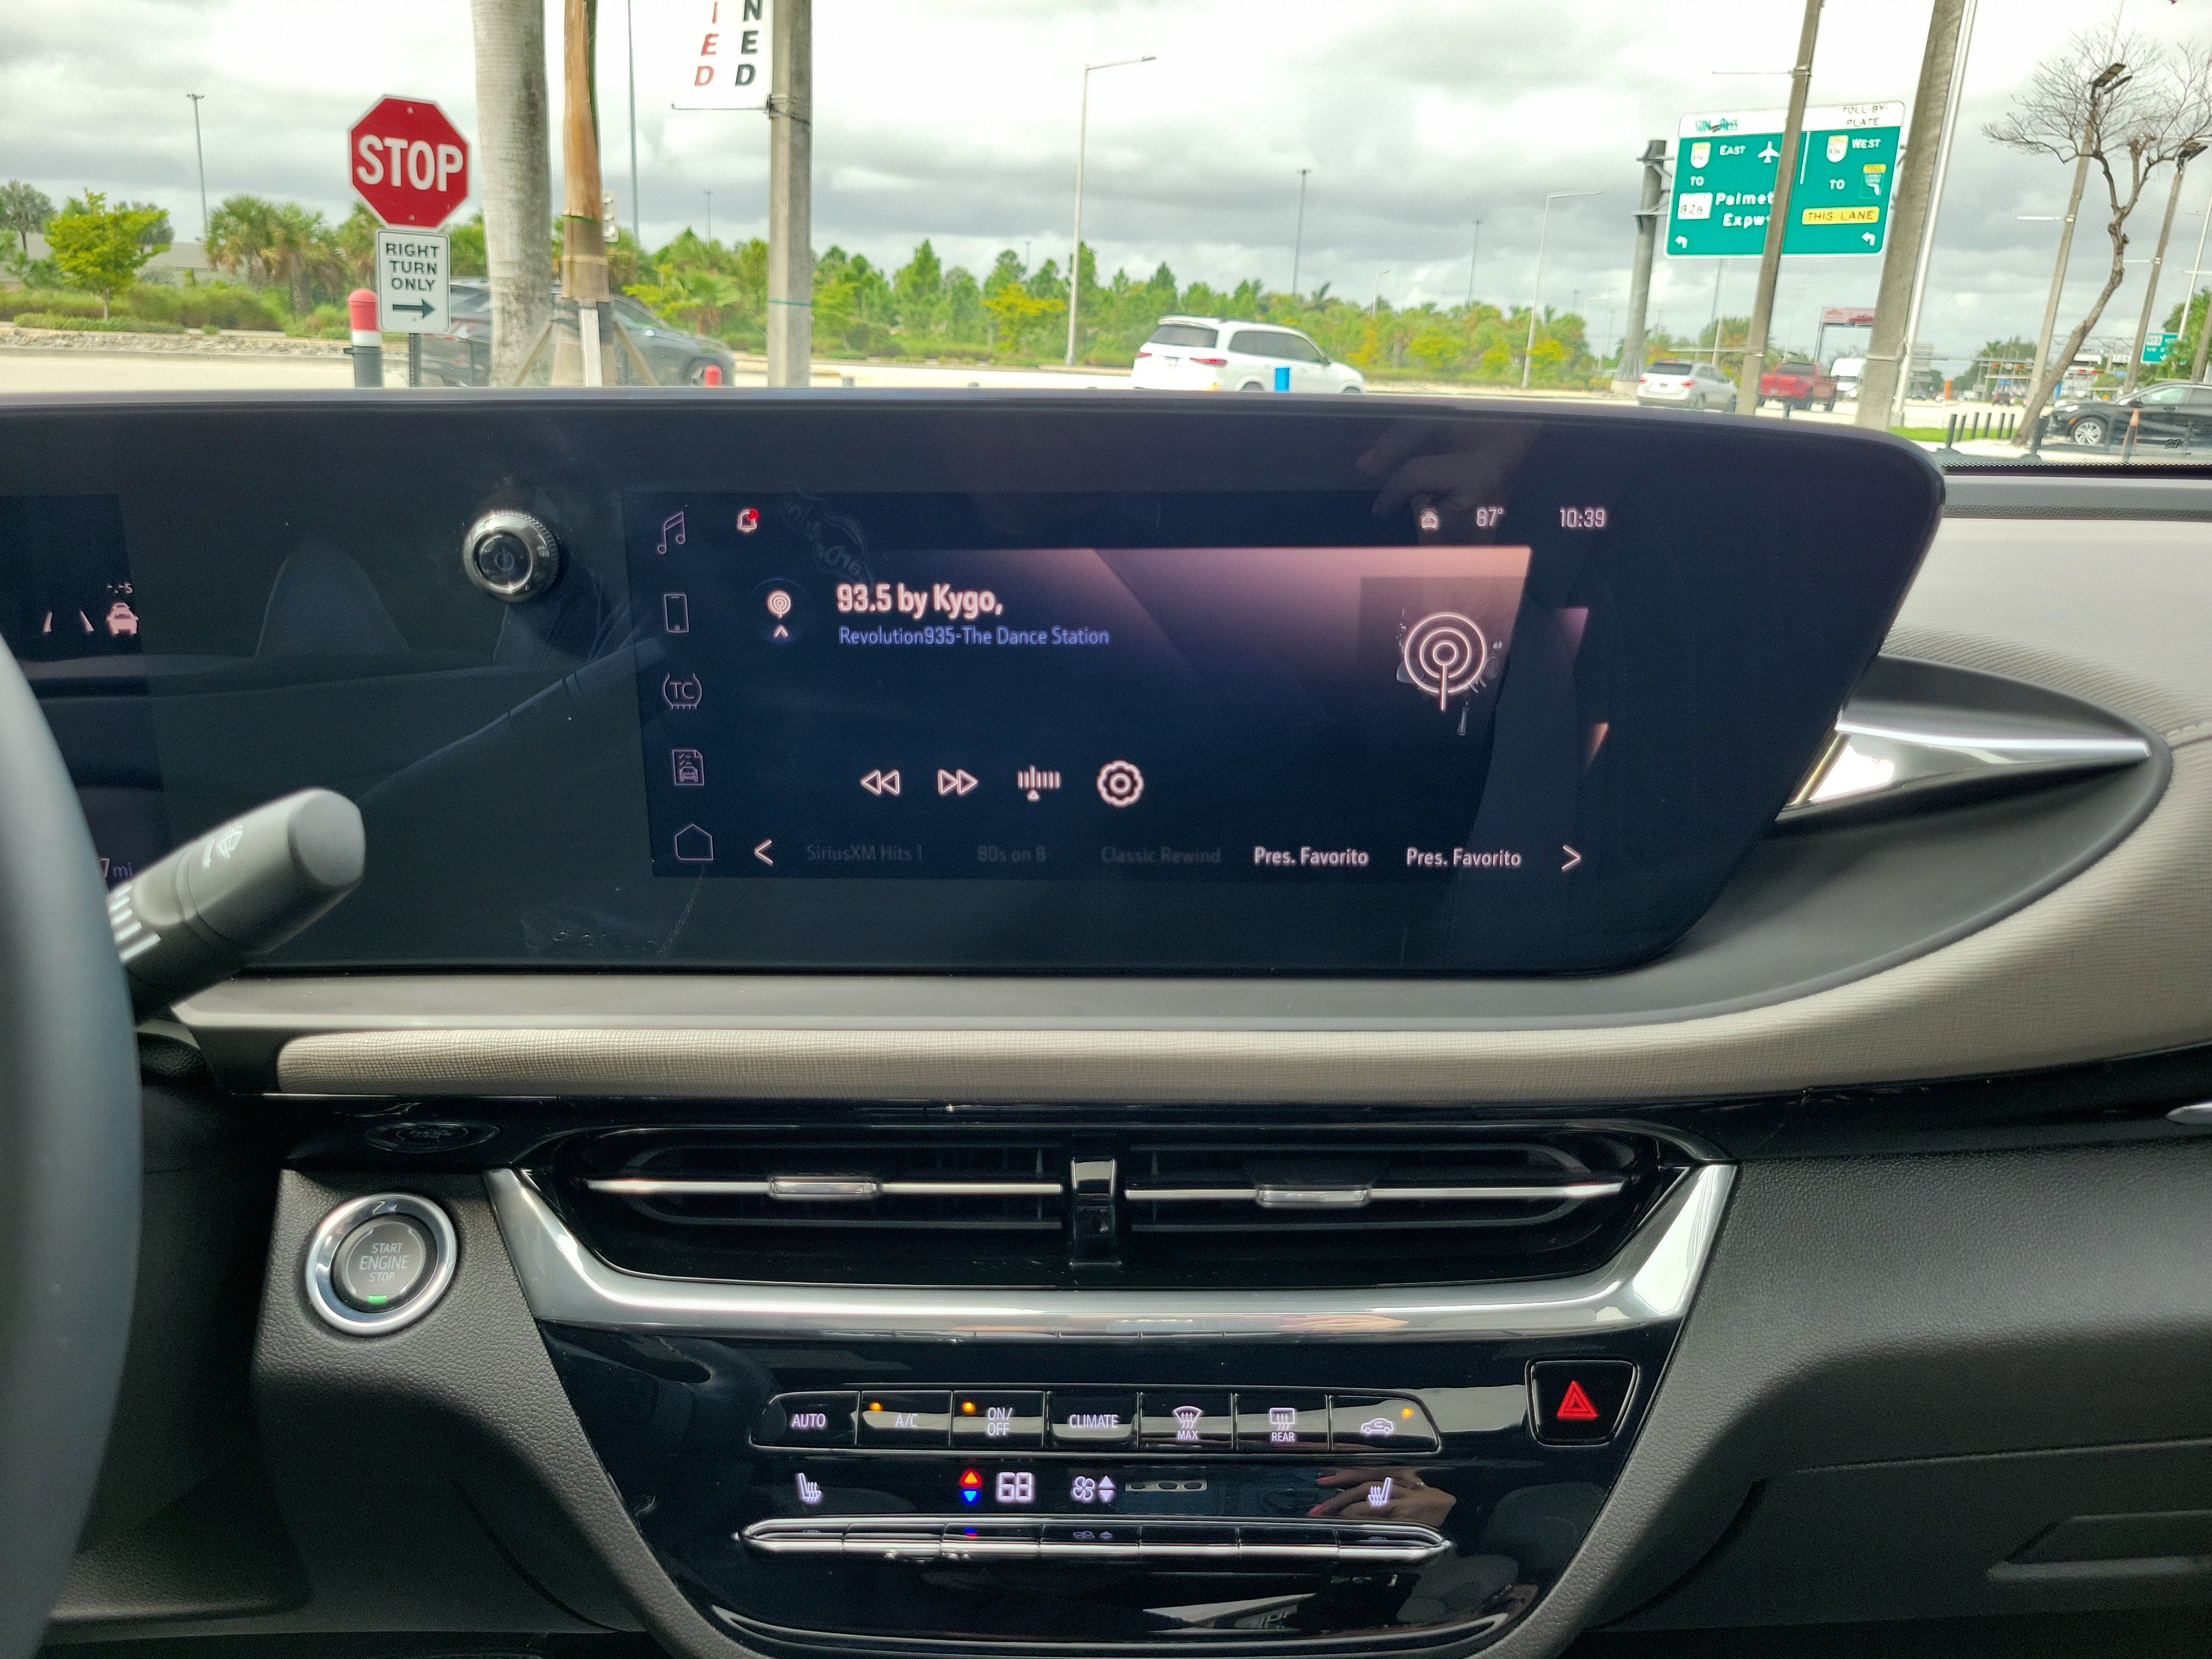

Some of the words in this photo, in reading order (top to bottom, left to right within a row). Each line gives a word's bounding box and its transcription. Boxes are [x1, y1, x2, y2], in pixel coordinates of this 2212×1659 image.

[1847, 118, 1880, 127] PLATE
[1719, 144, 1746, 156] EAST
[1852, 138, 1881, 149] WEST
[357, 134, 464, 192] STOP
[1690, 176, 1705, 187] TO
[1829, 179, 1846, 190] TO
[1809, 212, 1833, 221] THIS
[1841, 211, 1875, 221] LANE
[386, 243, 441, 257] RIGHT
[390, 261, 437, 274] TURN
[392, 278, 436, 291] ONLY
[1560, 507, 1605, 528] 10:39
[837, 583, 891, 612] 93.5
[898, 583, 927, 619] by
[933, 583, 1003, 619] Kygo,
[839, 625, 992, 645] Revolution935-The
[996, 625, 1047, 645] Dance
[1051, 625, 1110, 645] Station
[670, 682, 695, 699] TC
[807, 844, 876, 861] SiriusXM
[881, 845, 912, 861] Hits
[977, 845, 1007, 862] 80s
[1012, 849, 1031, 862] on
[1101, 846, 1156, 864] Classic
[1160, 846, 1221, 864] Rewind
[1254, 847, 1296, 865] Pres.
[1300, 847, 1370, 865] Favorito
[1406, 848, 1447, 866] Pres.
[1453, 848, 1522, 866] Favorito
[372, 1243, 403, 1254] START
[359, 1255, 410, 1270] ENGINE
[369, 1271, 395, 1282] STOP
[792, 1413, 826, 1427] AUTO
[895, 1413, 918, 1427] A/C
[988, 1407, 1013, 1421] ON/
[1069, 1414, 1119, 1428] CLIMATE
[988, 1422, 1010, 1436] OFF
[1177, 1430, 1198, 1441] MAX
[1271, 1432, 1295, 1442] REAR
[998, 1472, 1032, 1500] 68
